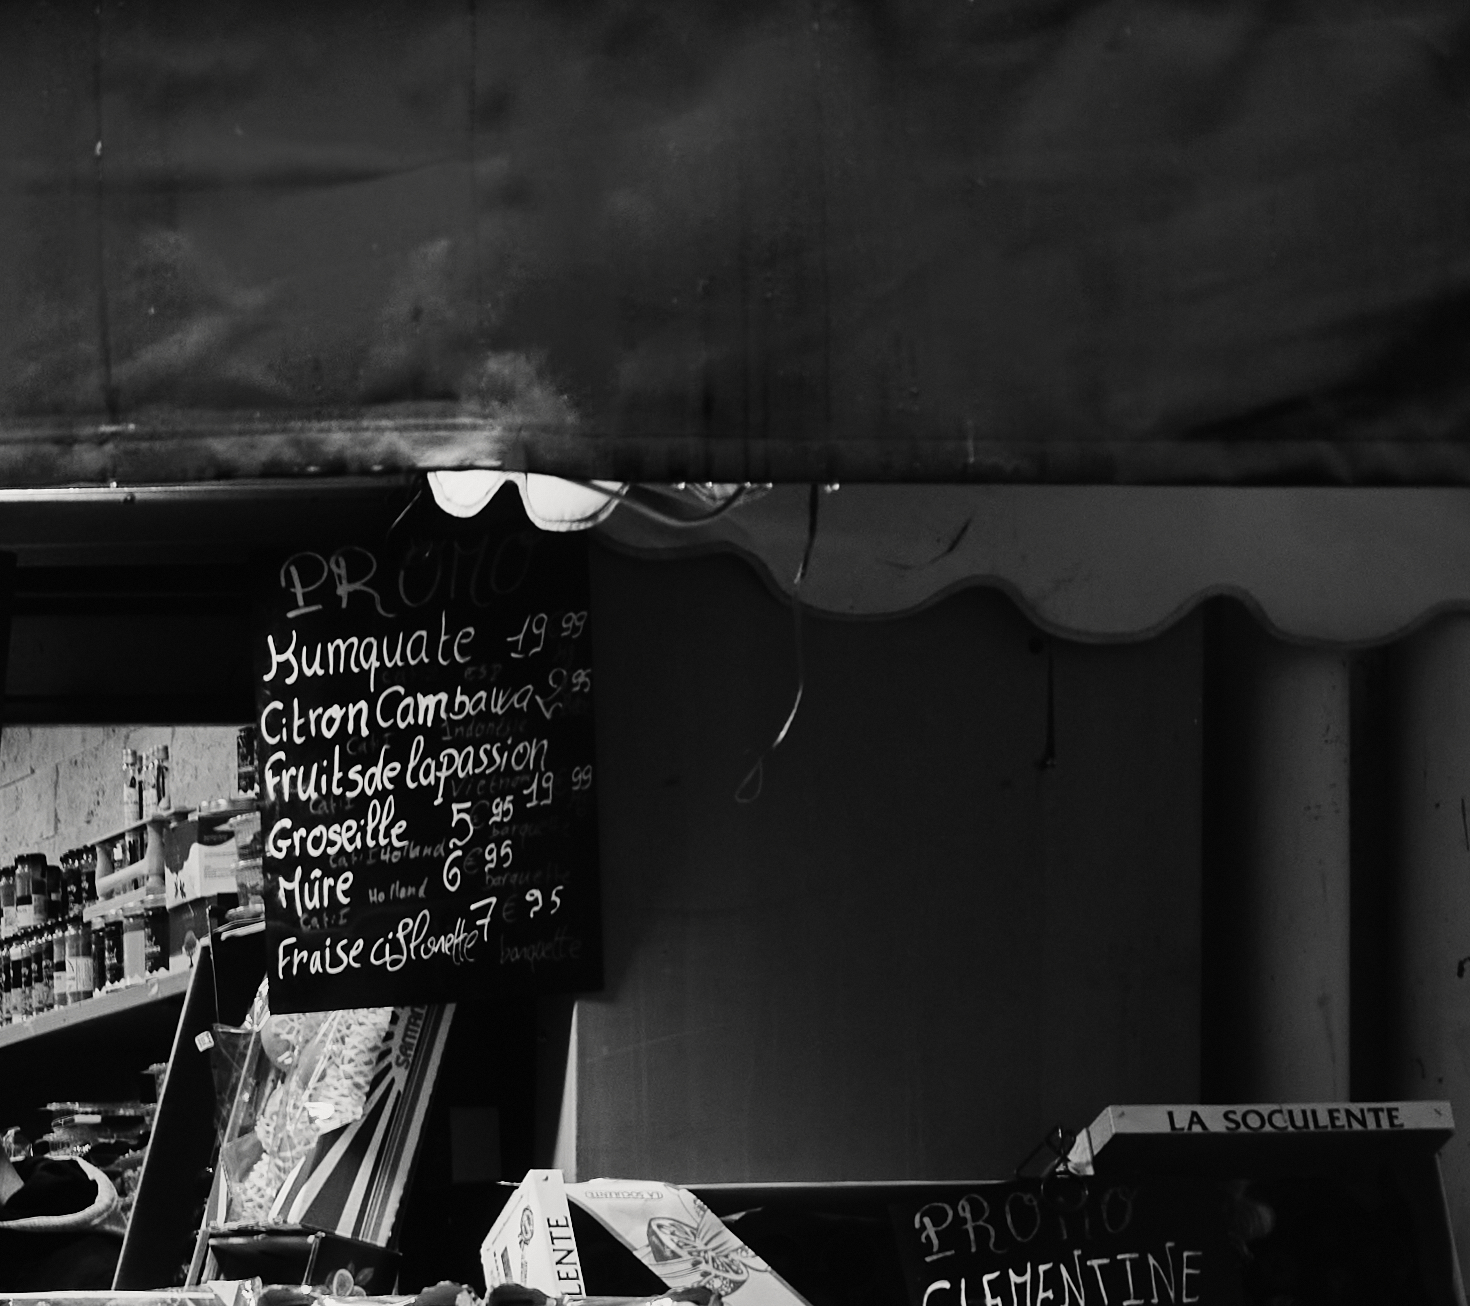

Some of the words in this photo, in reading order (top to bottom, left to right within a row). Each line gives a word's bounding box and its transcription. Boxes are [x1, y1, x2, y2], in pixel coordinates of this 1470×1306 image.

[262, 608, 477, 695] Kumquate
[260, 696, 372, 745] Citron
[266, 793, 409, 860] Groseille
[277, 865, 355, 919] Mûre
[277, 936, 366, 980] Fraise
[1167, 1108, 1210, 1133] LA
[1223, 1105, 1406, 1132] SOCULENTE
[547, 1216, 586, 1299] LENTE
